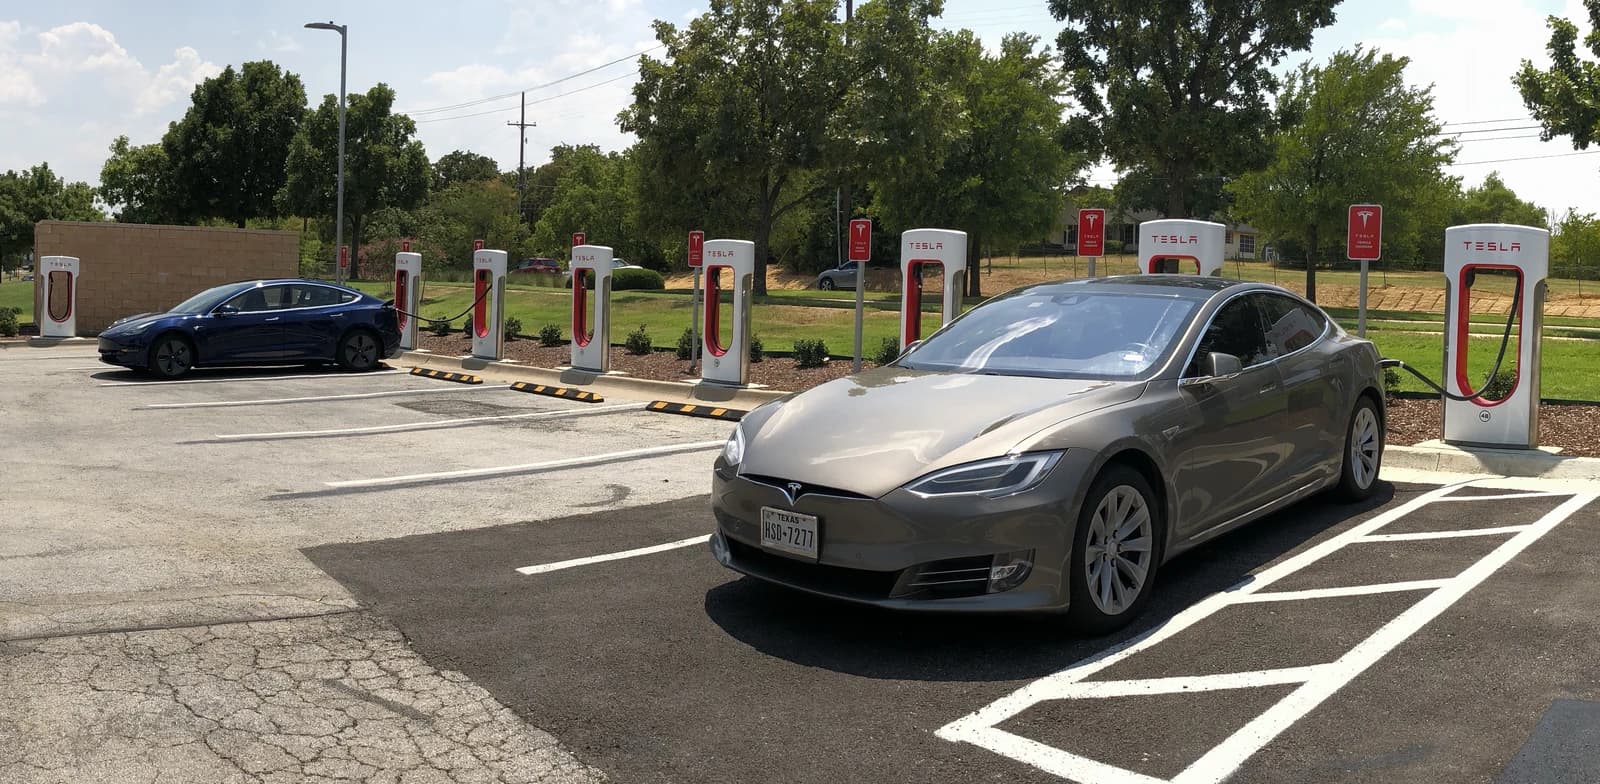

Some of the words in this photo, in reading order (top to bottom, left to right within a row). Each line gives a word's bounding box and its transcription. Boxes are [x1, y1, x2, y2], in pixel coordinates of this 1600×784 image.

[1152, 235, 1198, 244] TESLA
[909, 242, 943, 250] TESLA
[1464, 241, 1521, 252] TESLA
[708, 250, 734, 258] TESLA
[777, 513, 800, 524] TEXAS
